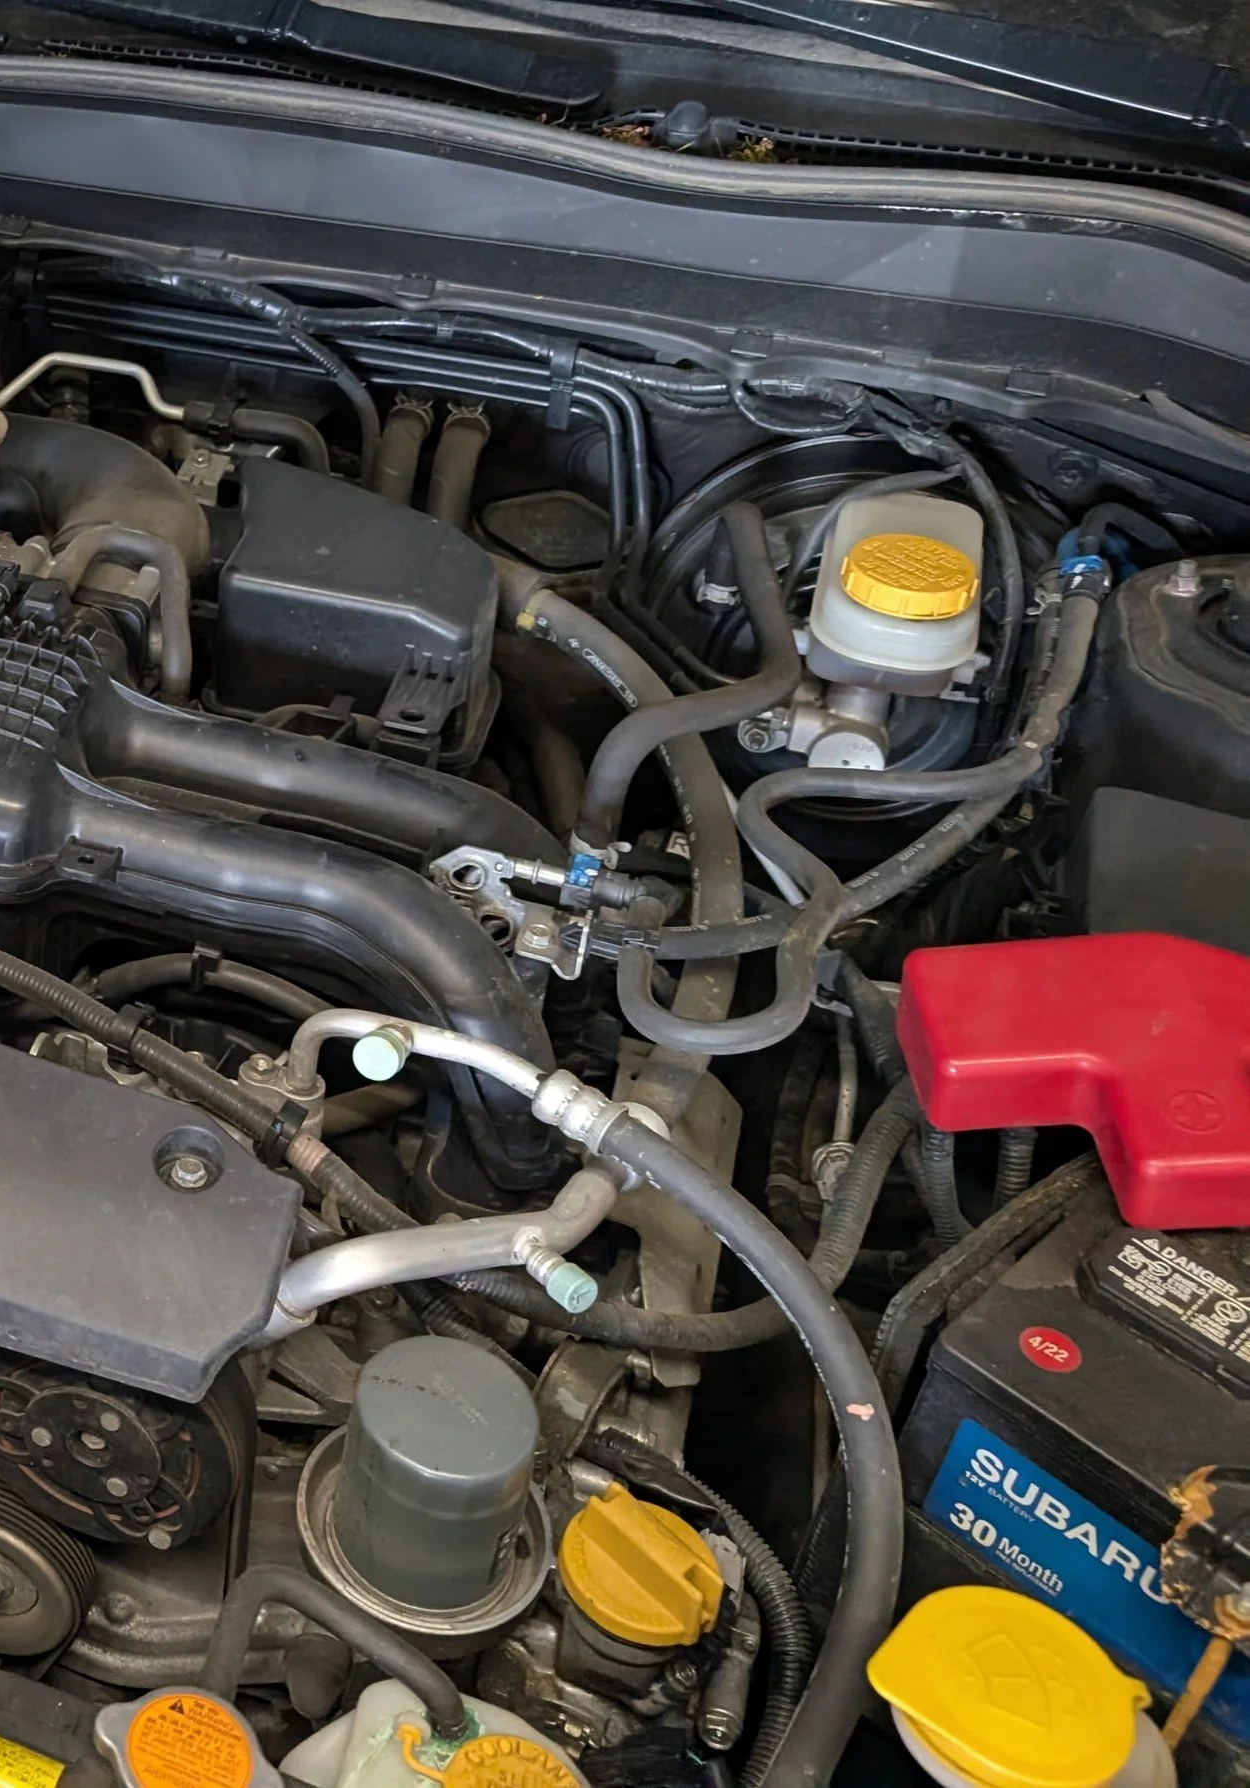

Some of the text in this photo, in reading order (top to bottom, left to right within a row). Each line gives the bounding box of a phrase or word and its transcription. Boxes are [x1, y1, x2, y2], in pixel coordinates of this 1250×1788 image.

[1161, 1246, 1239, 1297] DANGER
[1027, 1335, 1069, 1363] 4/22
[964, 1469, 1036, 1525] 12V BATTERY
[949, 1501, 1064, 1593] 30 Month
[969, 1447, 1172, 1606] SUBARU
[464, 1737, 570, 1783] COOLAN
